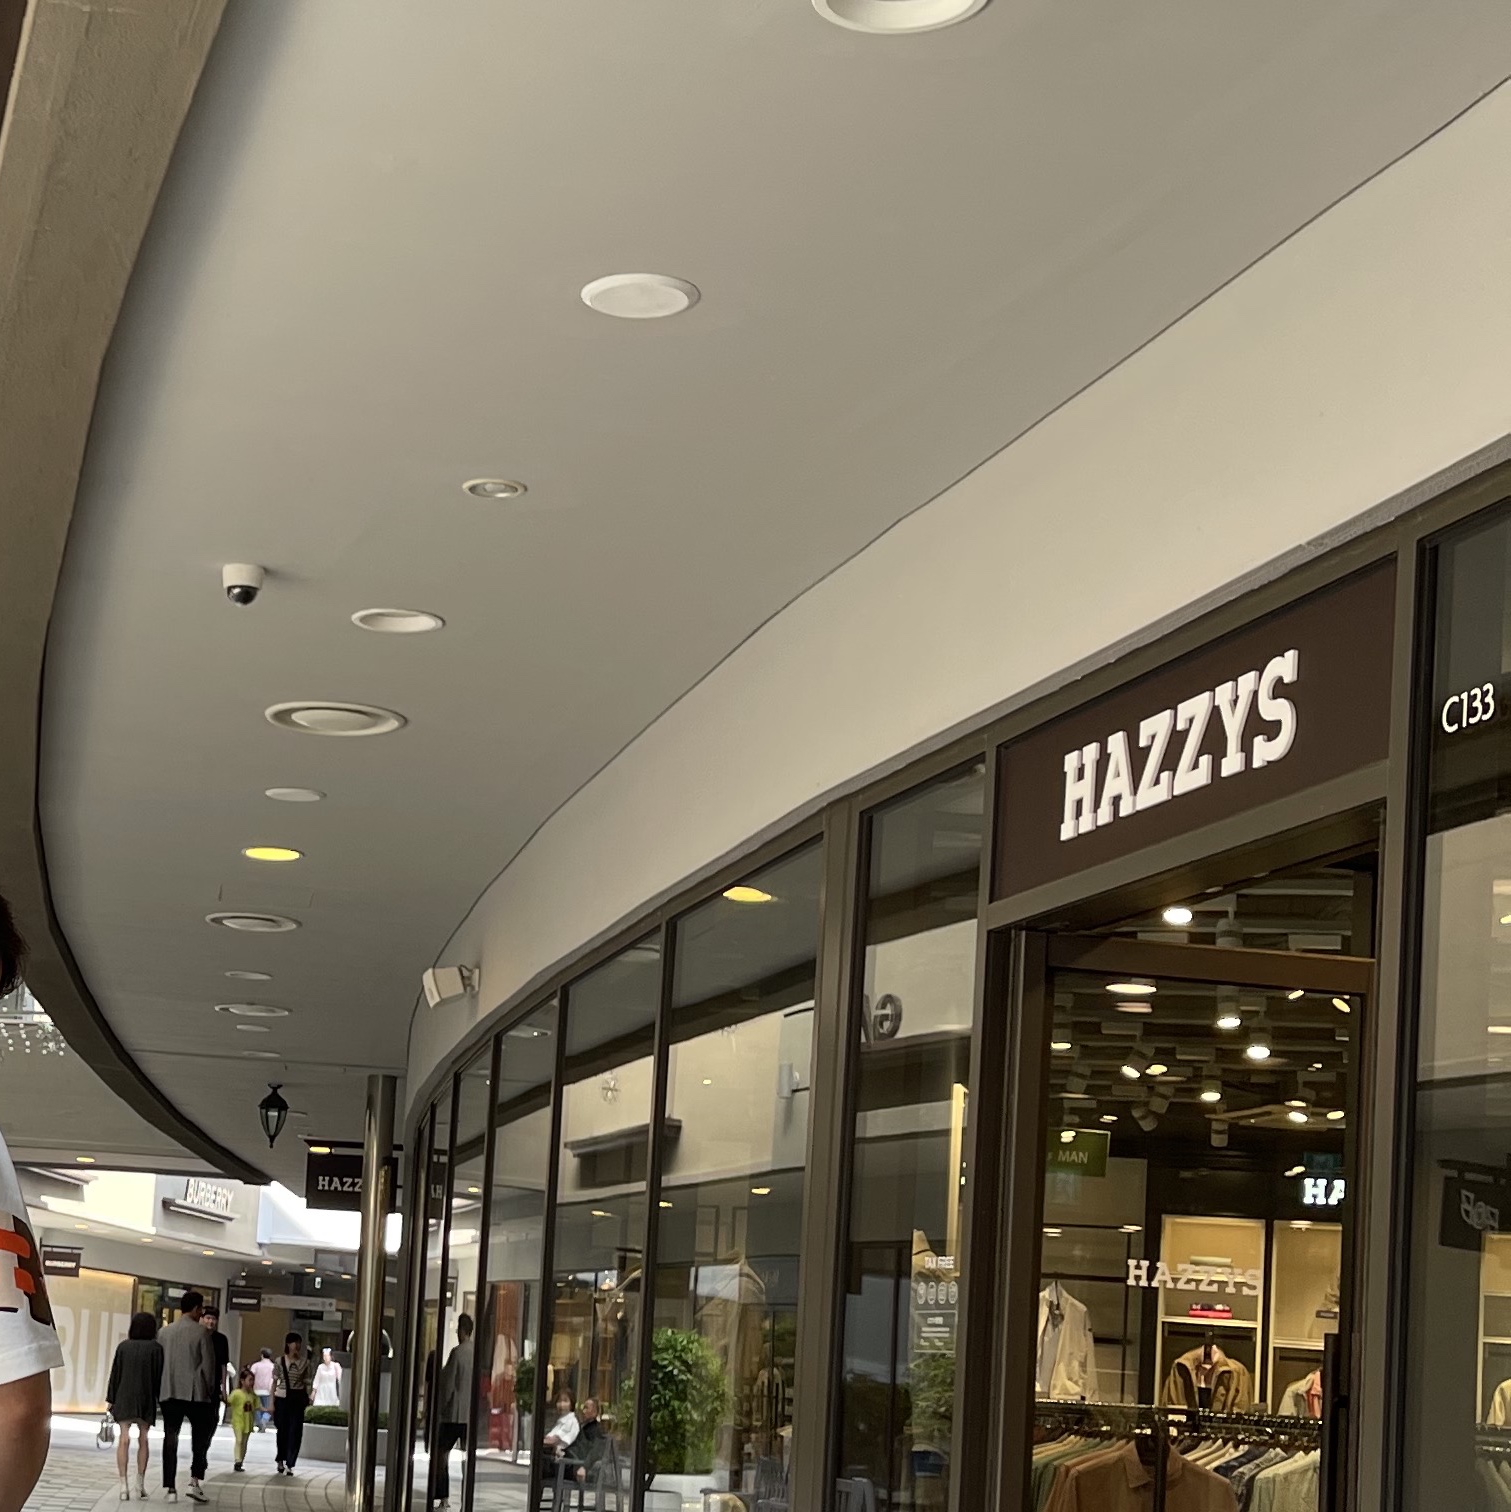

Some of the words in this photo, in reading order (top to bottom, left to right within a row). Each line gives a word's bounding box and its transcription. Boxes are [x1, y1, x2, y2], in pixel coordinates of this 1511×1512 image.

[1441, 682, 1496, 734] C133
[1059, 648, 1300, 842] HAZZYS
[1057, 1149, 1089, 1165] MAN
[186, 1178, 235, 1213] BURBERRY
[317, 1175, 362, 1192] HAZZ
[1126, 1258, 1262, 1296] HAZZYS
